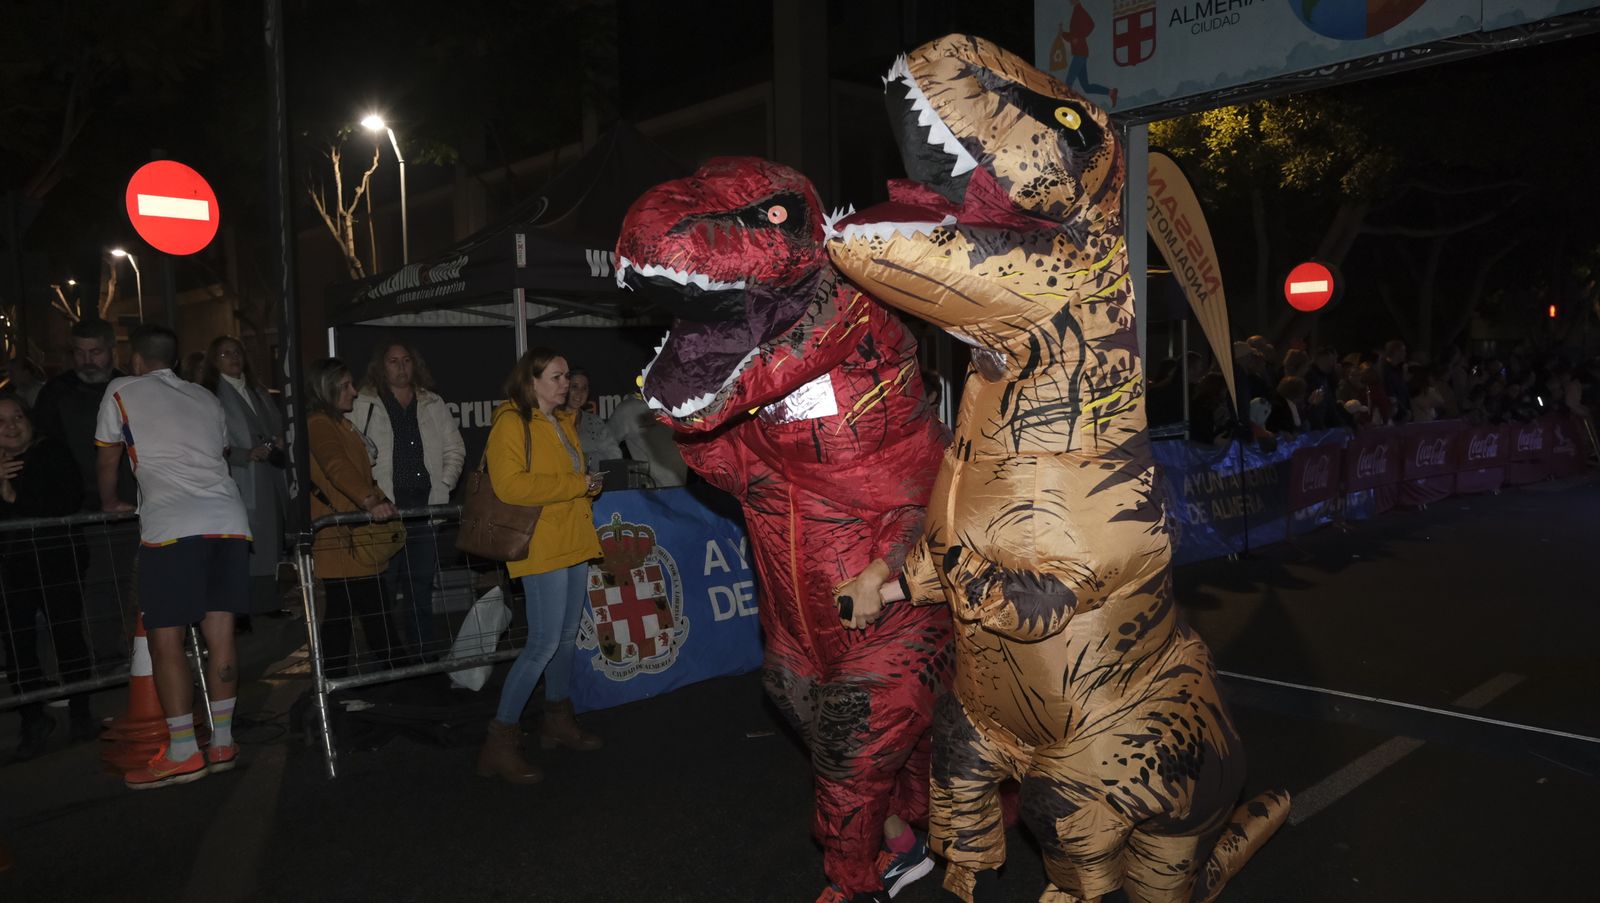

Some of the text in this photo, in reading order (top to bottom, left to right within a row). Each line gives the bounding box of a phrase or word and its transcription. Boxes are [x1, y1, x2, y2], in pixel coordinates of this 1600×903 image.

[1168, 0, 1264, 27] ALMER
[1191, 12, 1240, 35] CIUDAD
[708, 580, 759, 622] DE
